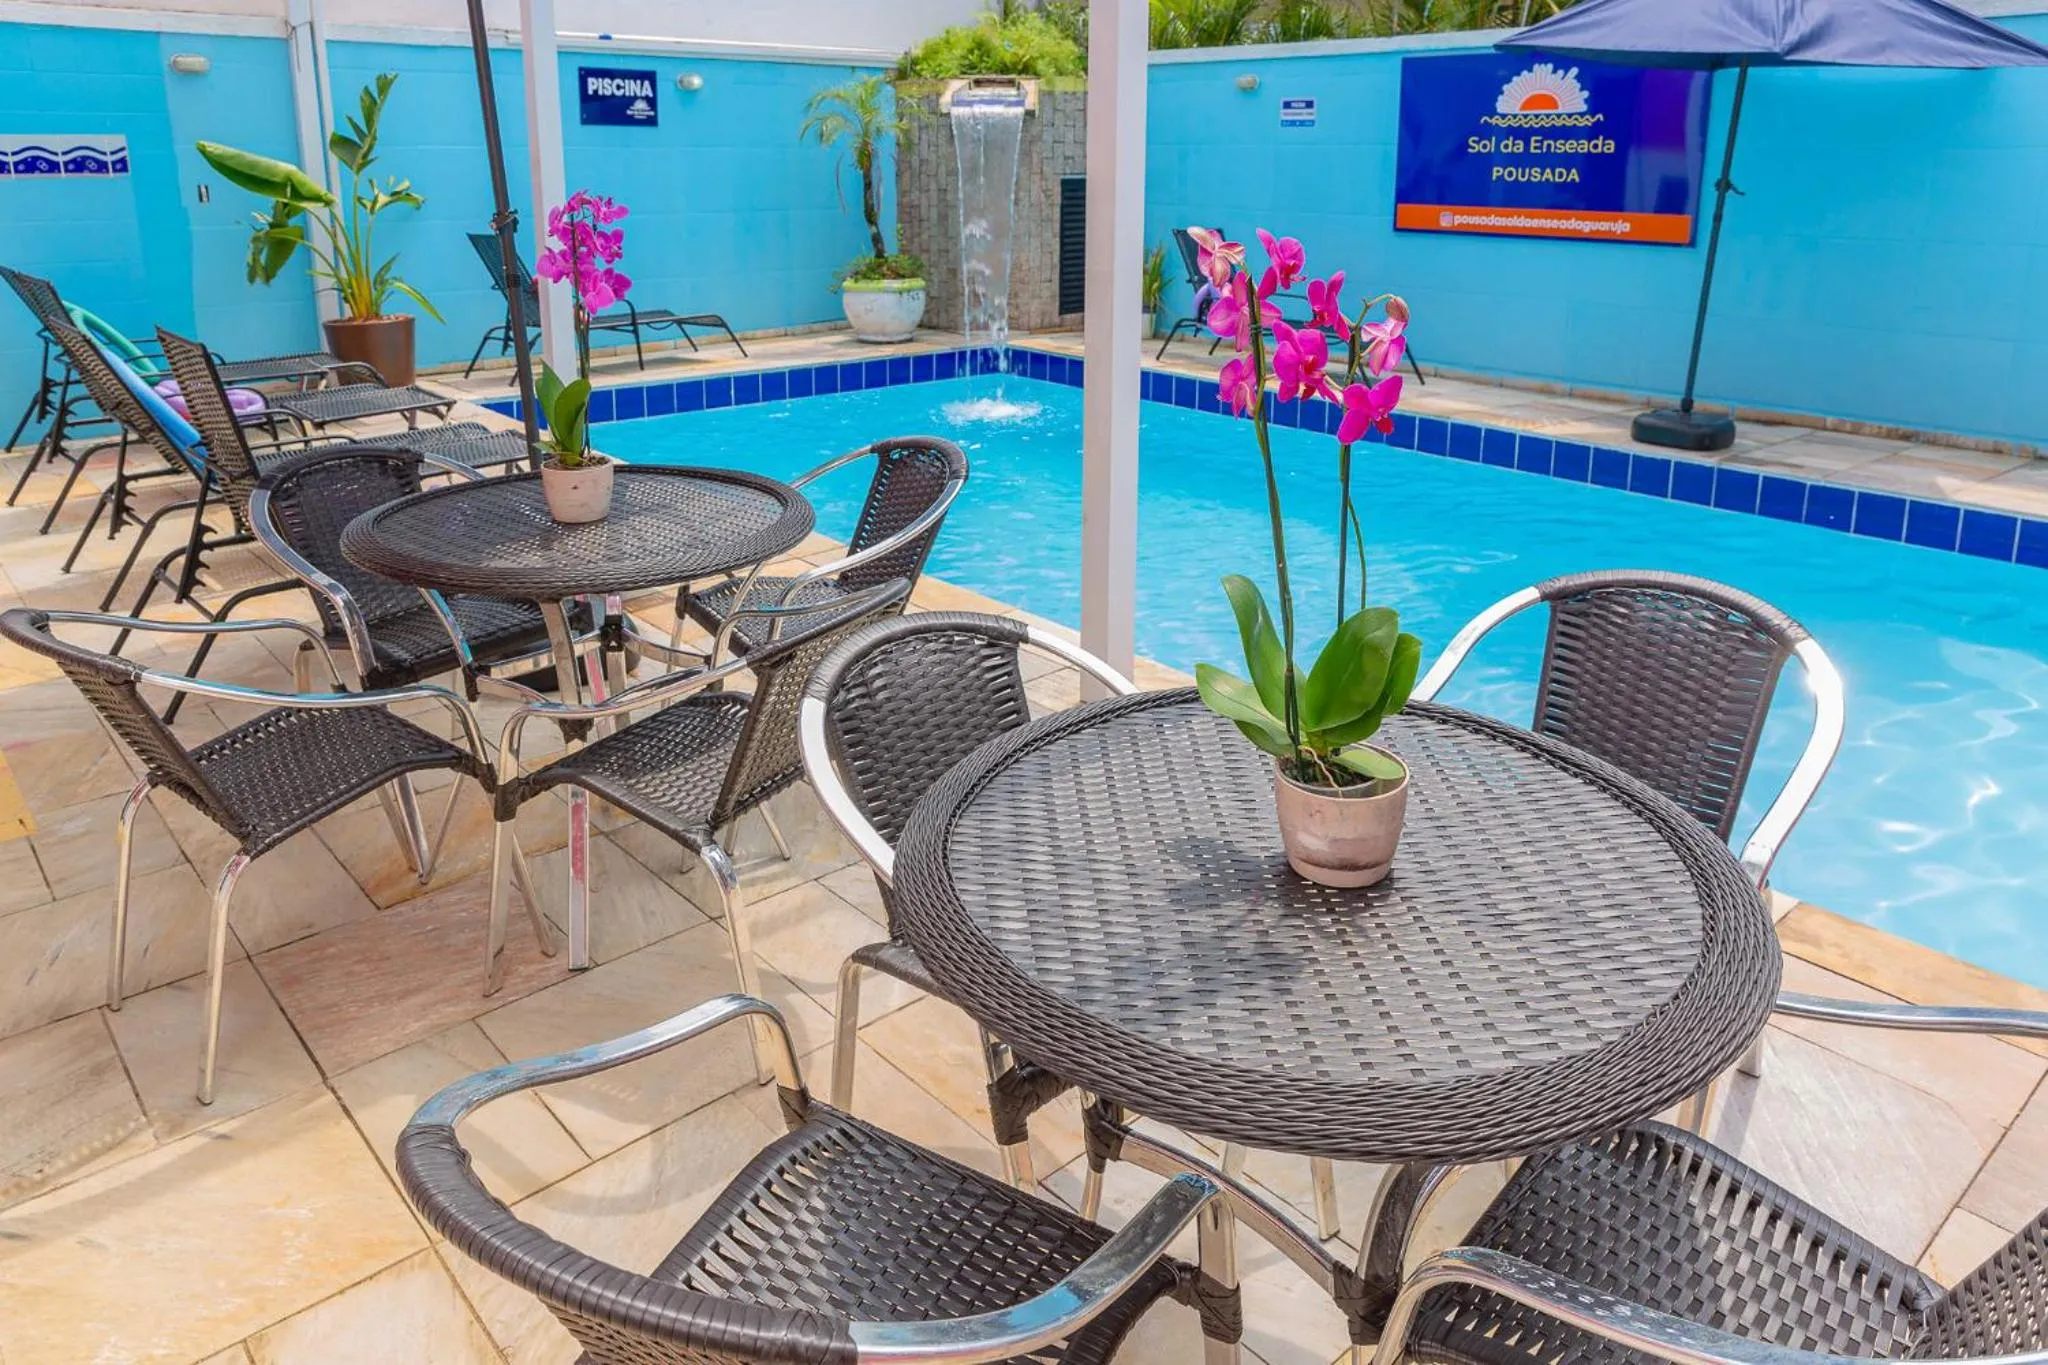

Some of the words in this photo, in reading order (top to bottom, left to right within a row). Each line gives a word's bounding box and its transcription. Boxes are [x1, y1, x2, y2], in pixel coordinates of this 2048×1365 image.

[587, 77, 653, 97] PISCINA
[1467, 136, 1496, 153] Sol
[1500, 136, 1525, 154] da
[1529, 135, 1616, 154] Enseada
[1491, 166, 1580, 183] POUSADA
